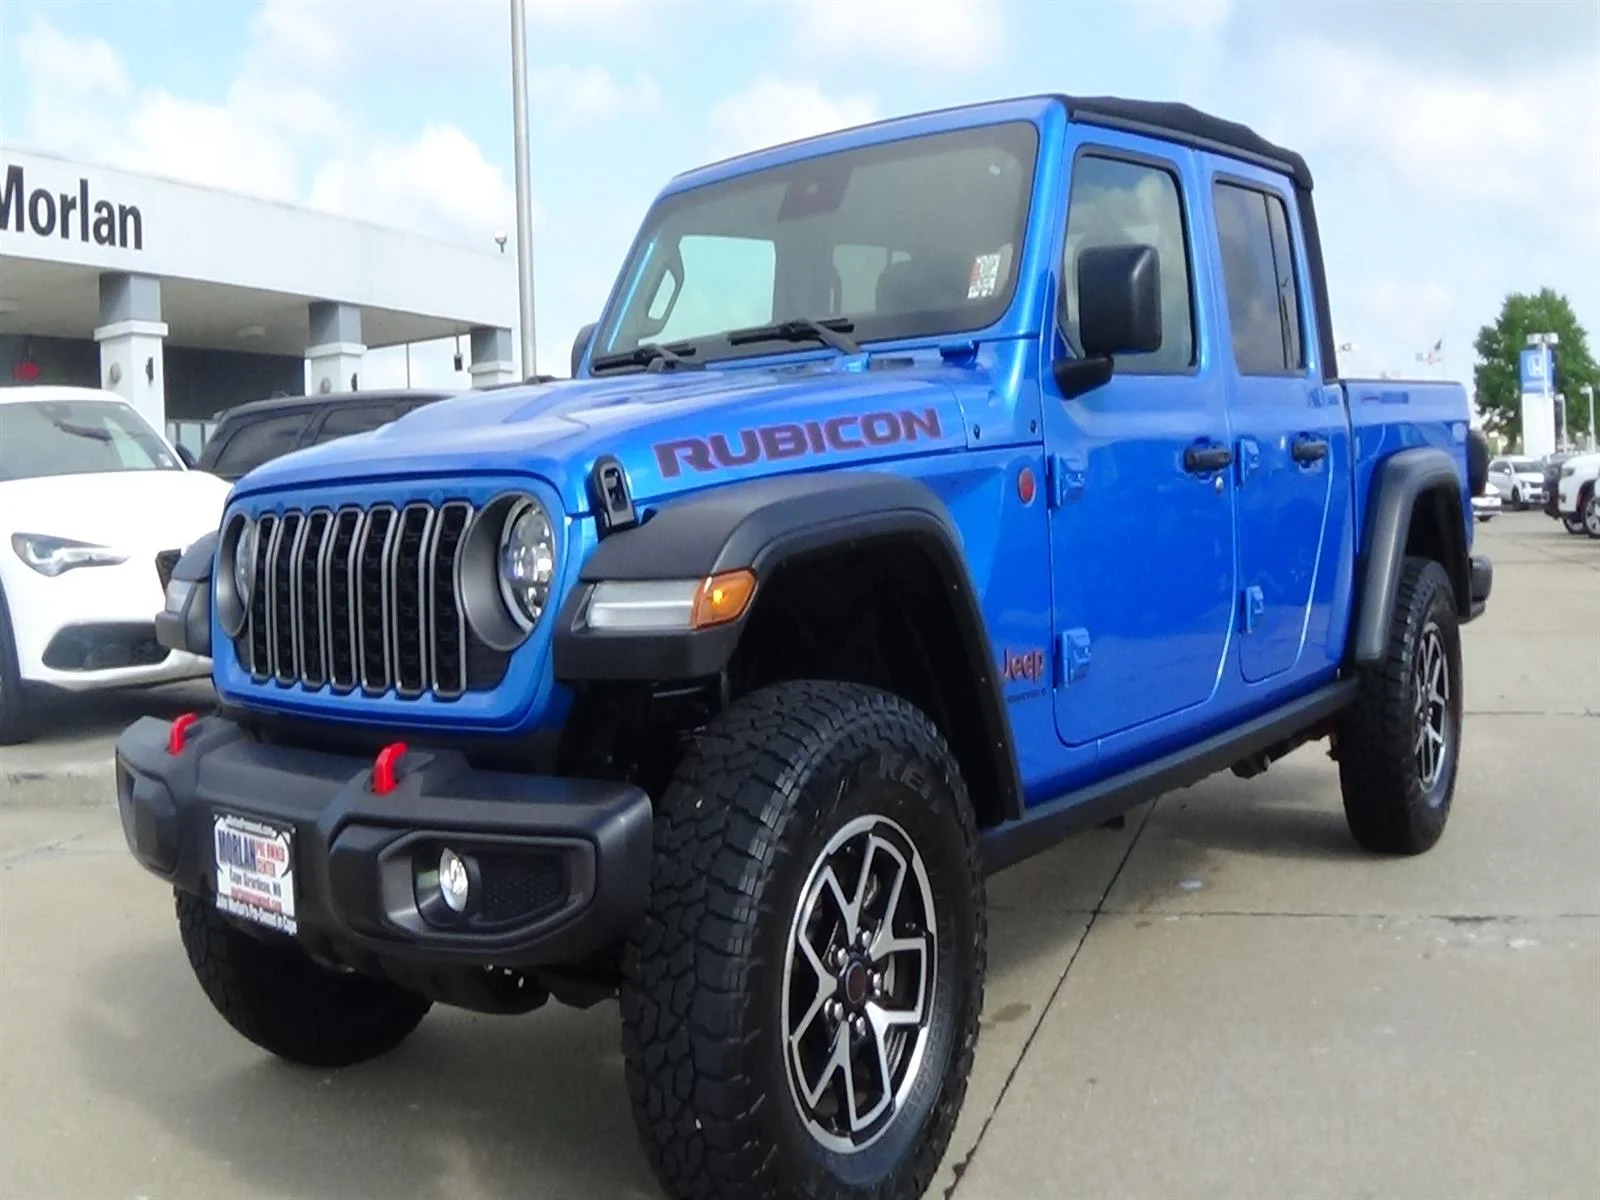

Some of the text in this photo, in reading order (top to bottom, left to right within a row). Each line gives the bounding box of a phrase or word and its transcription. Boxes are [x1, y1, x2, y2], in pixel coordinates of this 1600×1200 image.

[653, 407, 943, 479] RUBICON
[1002, 647, 1044, 683] Jeep
[217, 829, 257, 872] MORLAN
